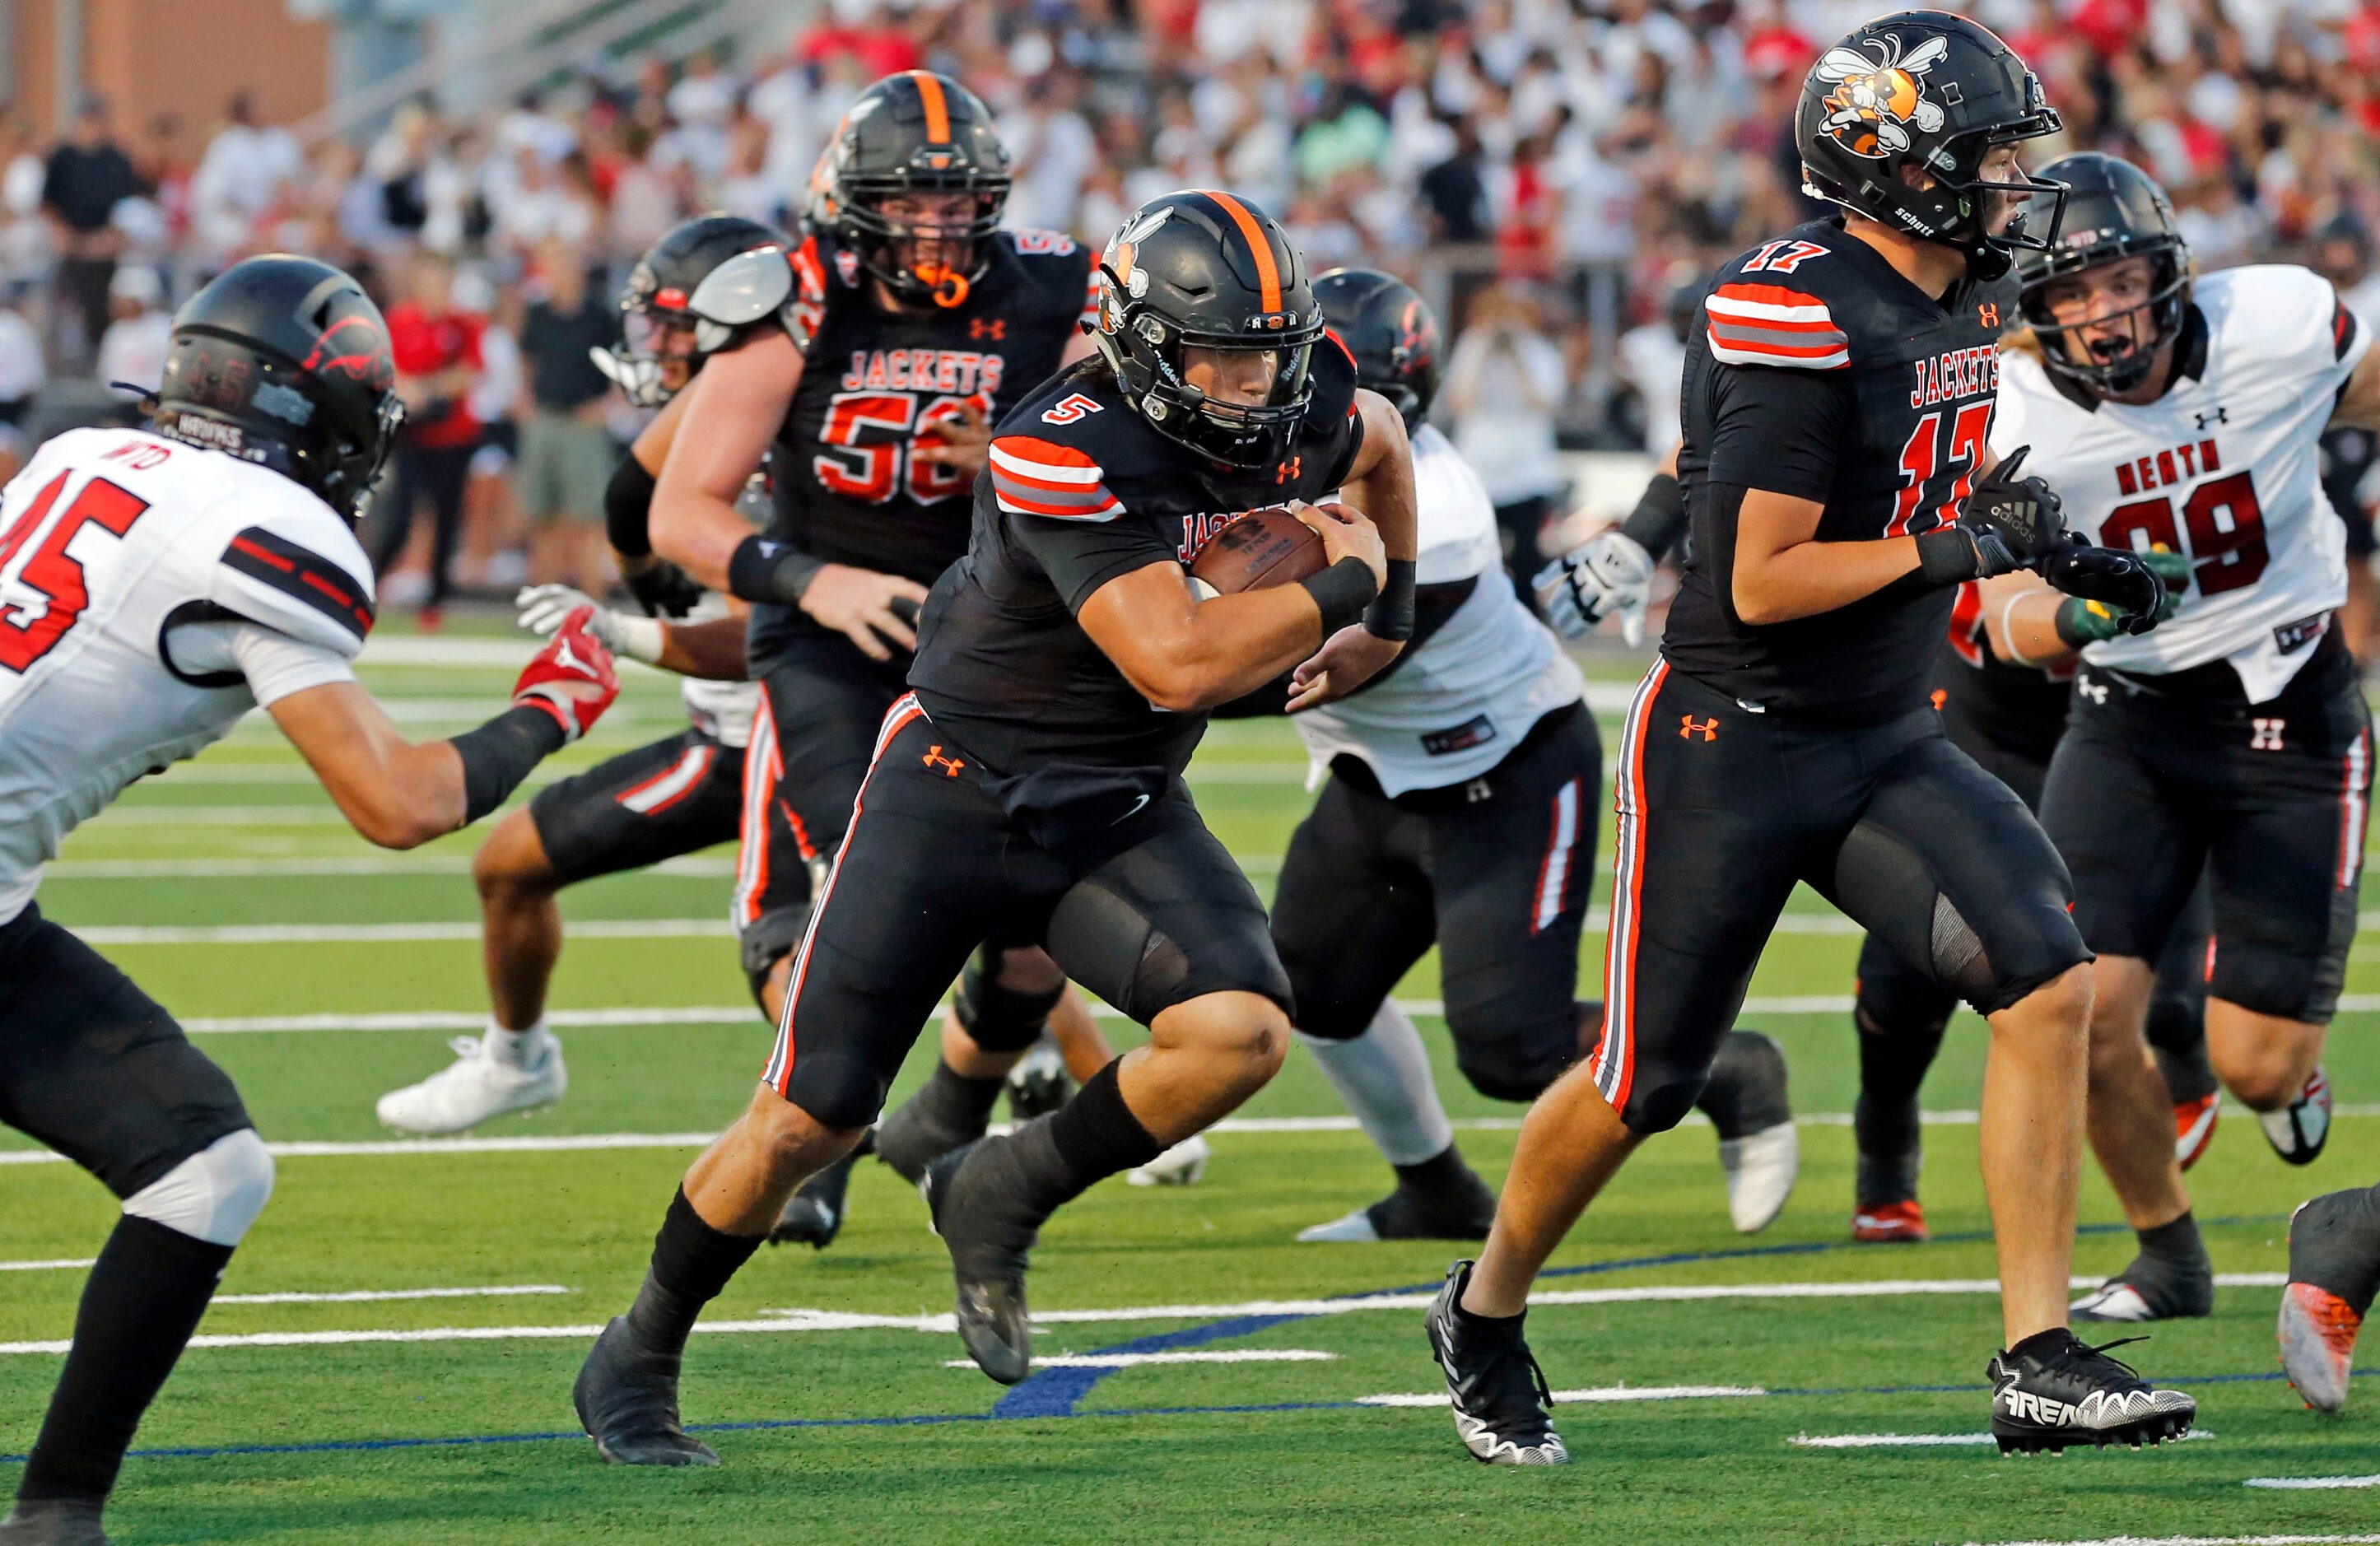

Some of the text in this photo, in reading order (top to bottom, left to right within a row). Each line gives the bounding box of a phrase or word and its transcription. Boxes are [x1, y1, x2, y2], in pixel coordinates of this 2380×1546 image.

[1894, 207, 1935, 237] schutt
[1740, 240, 1832, 274] 17
[841, 348, 1004, 395] JACKETS
[1911, 342, 1999, 408] JACKETS
[1041, 393, 1105, 426] 5
[1882, 398, 1995, 539] 17
[2116, 439, 2220, 496] HEATH
[1990, 505, 2036, 544] adidas
